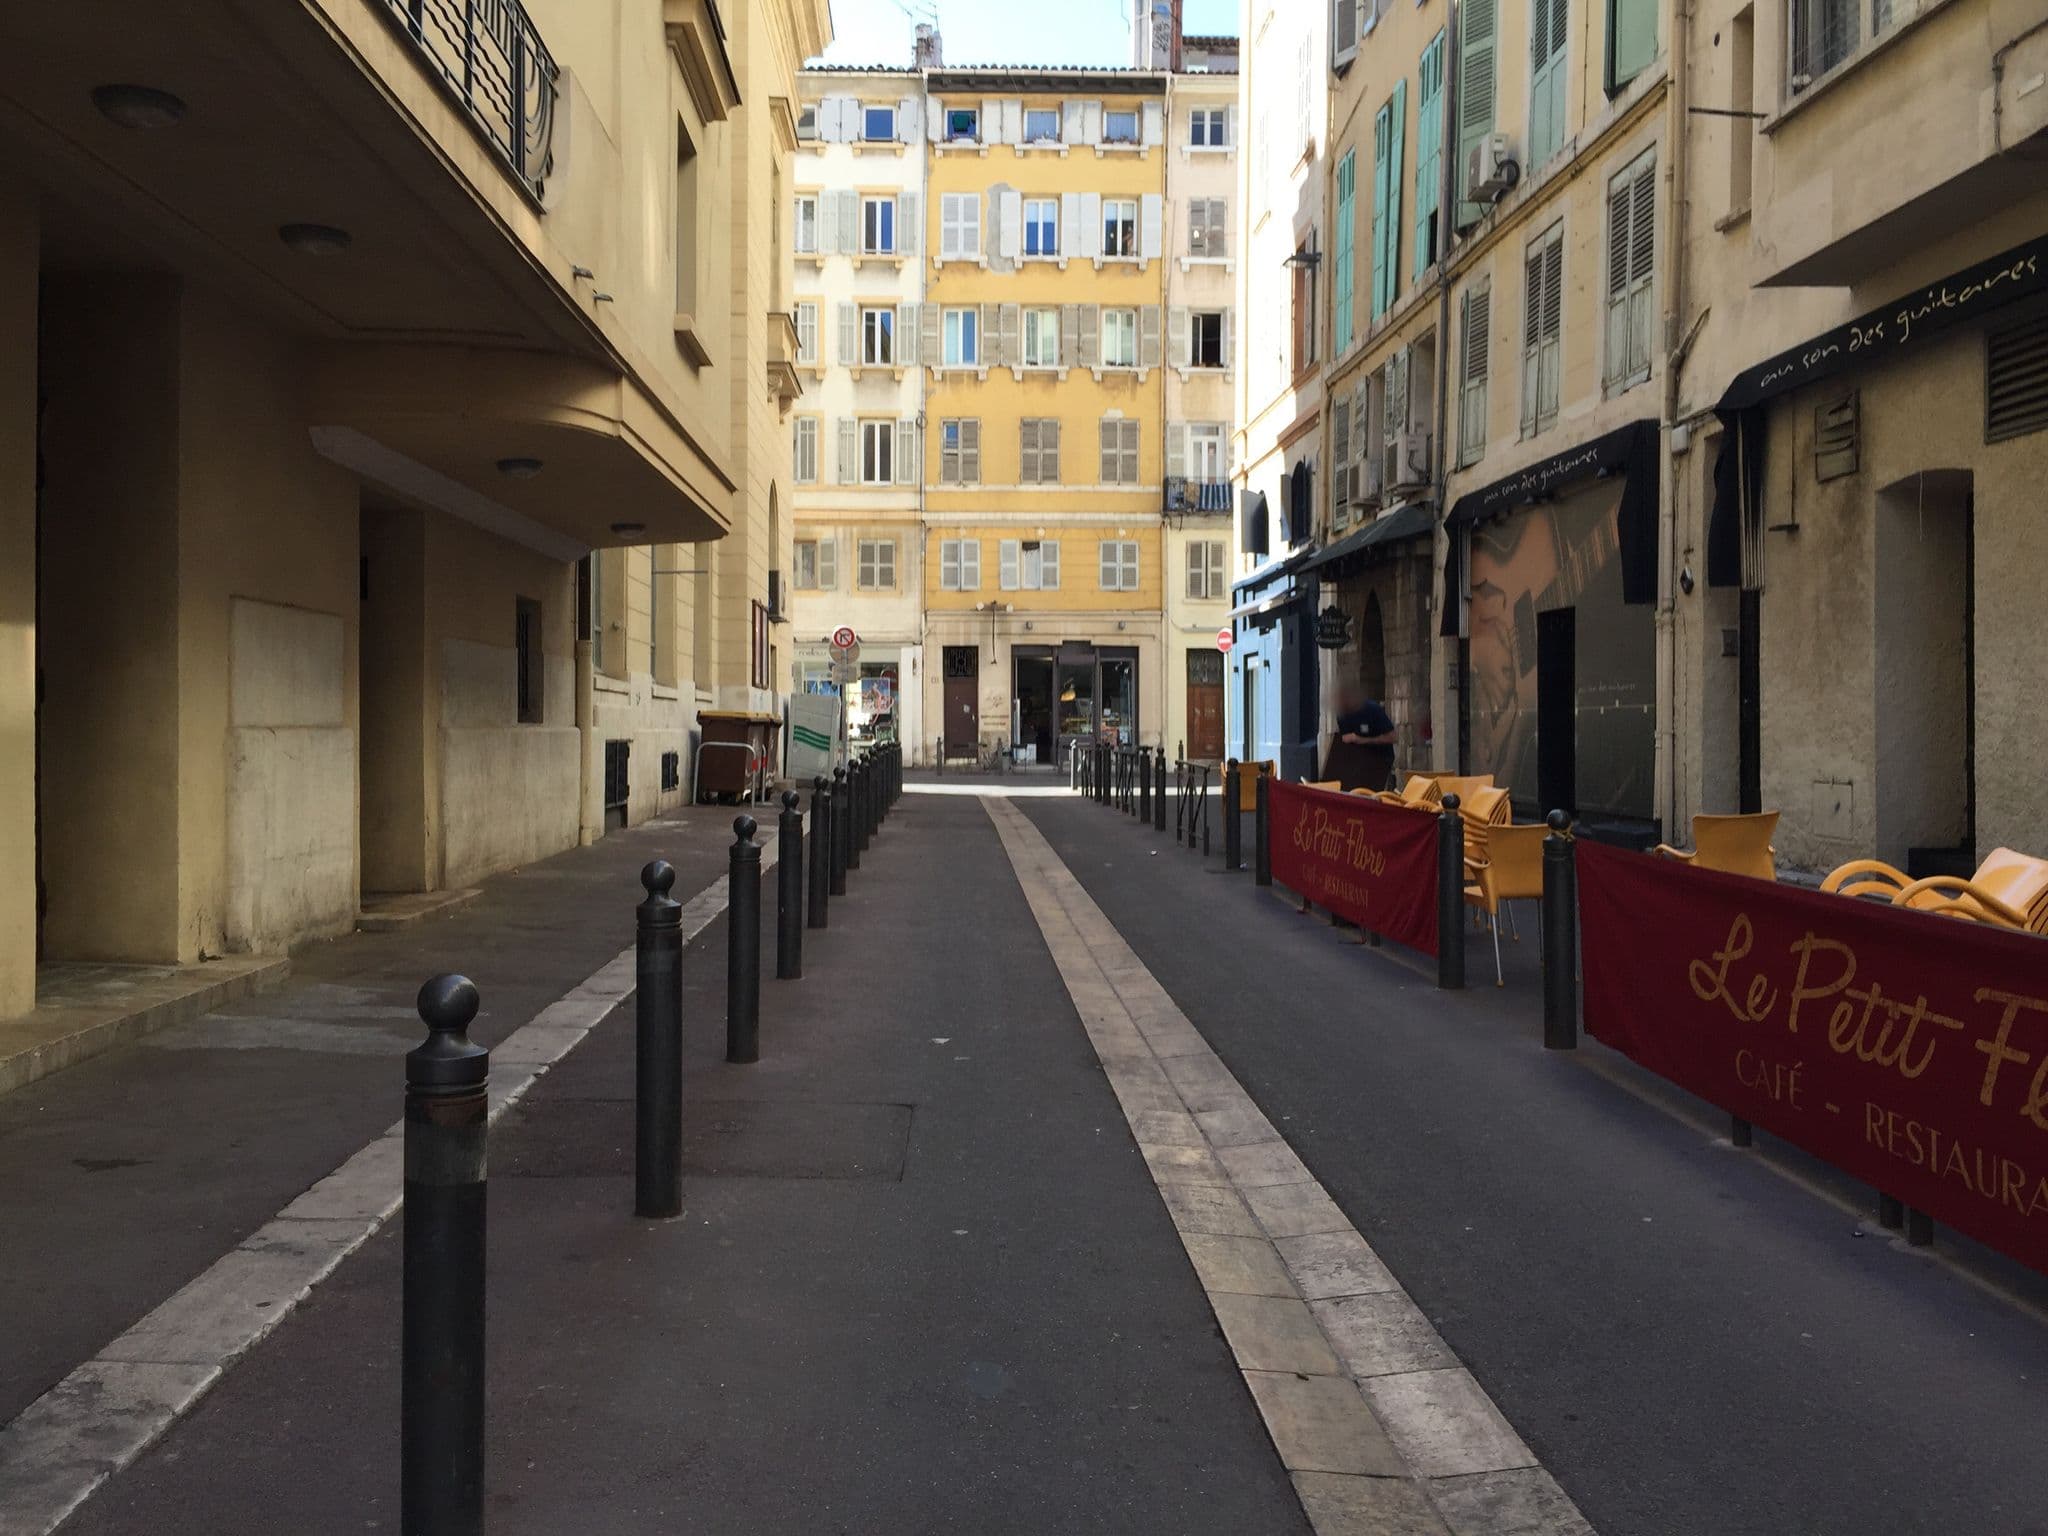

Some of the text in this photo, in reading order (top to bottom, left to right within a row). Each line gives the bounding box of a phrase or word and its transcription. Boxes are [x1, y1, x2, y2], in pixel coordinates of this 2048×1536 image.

[1760, 254, 2038, 388] au son des guitares
[1293, 801, 1387, 878] Le Petit Flore
[1688, 911, 1778, 1022] Le
[1787, 930, 1965, 1079] Petit
[1735, 1048, 1803, 1112] CAFÉ
